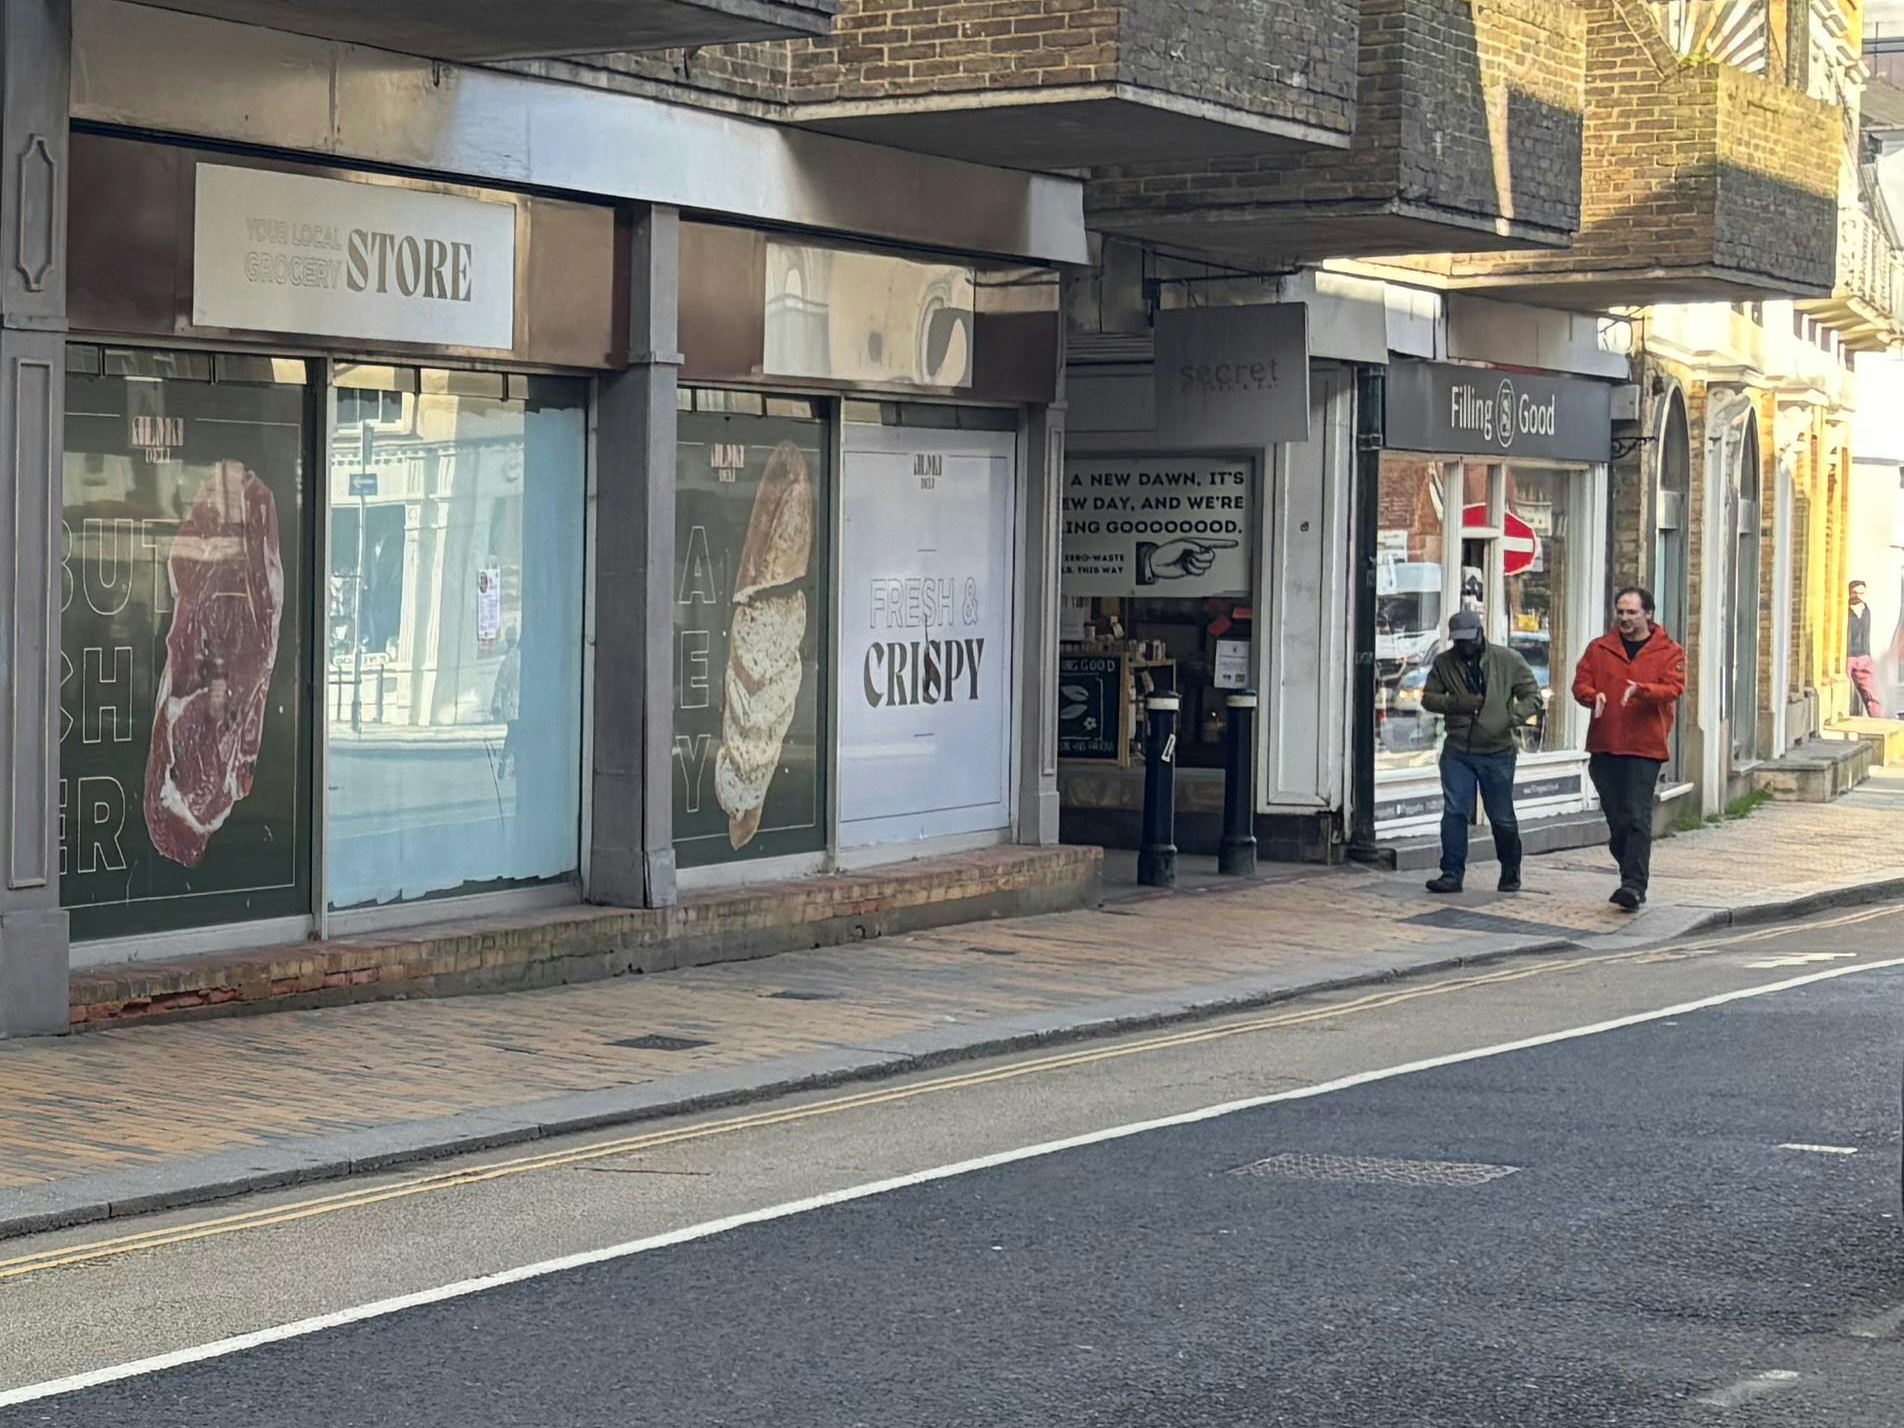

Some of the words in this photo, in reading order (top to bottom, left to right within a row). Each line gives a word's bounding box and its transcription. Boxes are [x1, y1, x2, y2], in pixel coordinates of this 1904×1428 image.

[346, 228, 472, 302] STORE
[1180, 357, 1279, 385] secret
[1451, 384, 1493, 441] Filling
[1519, 393, 1556, 436] Good
[1070, 473, 1083, 487] A
[1090, 473, 1131, 487] NEW
[1209, 471, 1245, 486] IT'S
[1140, 496, 1181, 510] AND
[1187, 495, 1244, 510] WE'RE
[60, 517, 183, 616] UT
[1102, 565, 1124, 574] WAY
[870, 577, 955, 629] FRESH
[962, 576, 978, 626] &
[863, 638, 985, 709] CRISPY
[1080, 659, 1116, 672] GOOD
[60, 646, 133, 744] H
[60, 776, 127, 876] R
